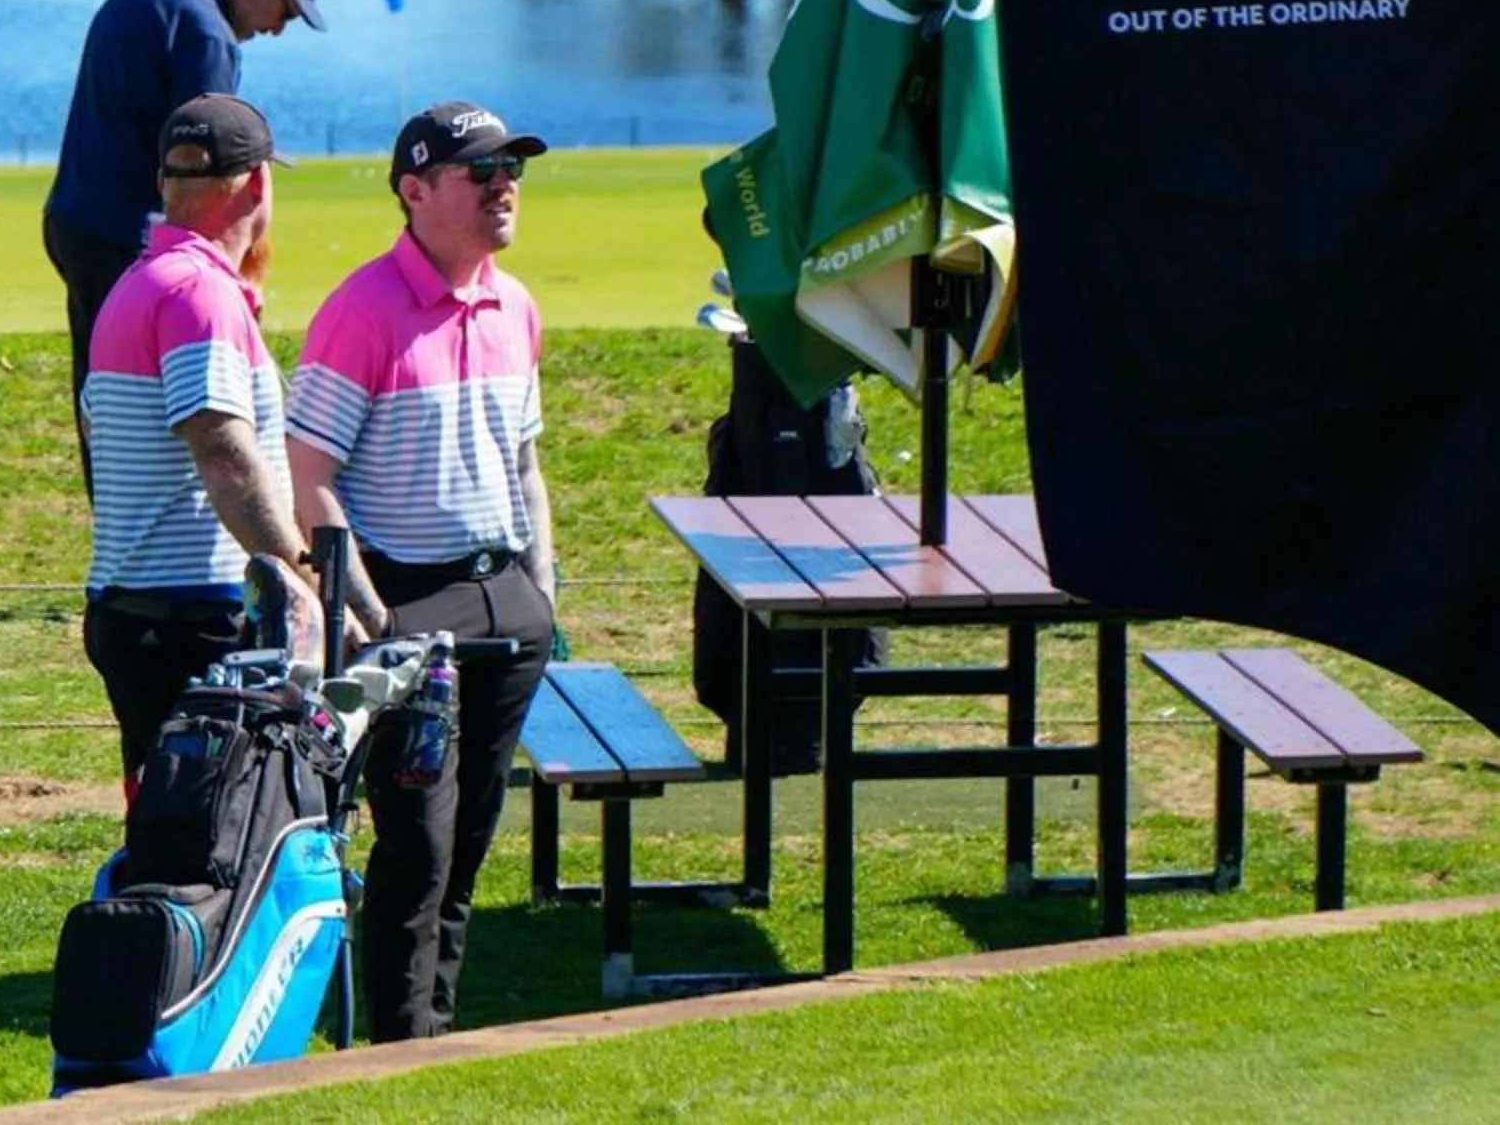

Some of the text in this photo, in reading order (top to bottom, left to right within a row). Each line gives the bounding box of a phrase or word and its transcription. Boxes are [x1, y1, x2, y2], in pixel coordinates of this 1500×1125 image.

[1108, 11, 1165, 33] OUT
[1171, 8, 1207, 31] OF
[1211, 5, 1266, 28] THE
[735, 165, 771, 237] World
